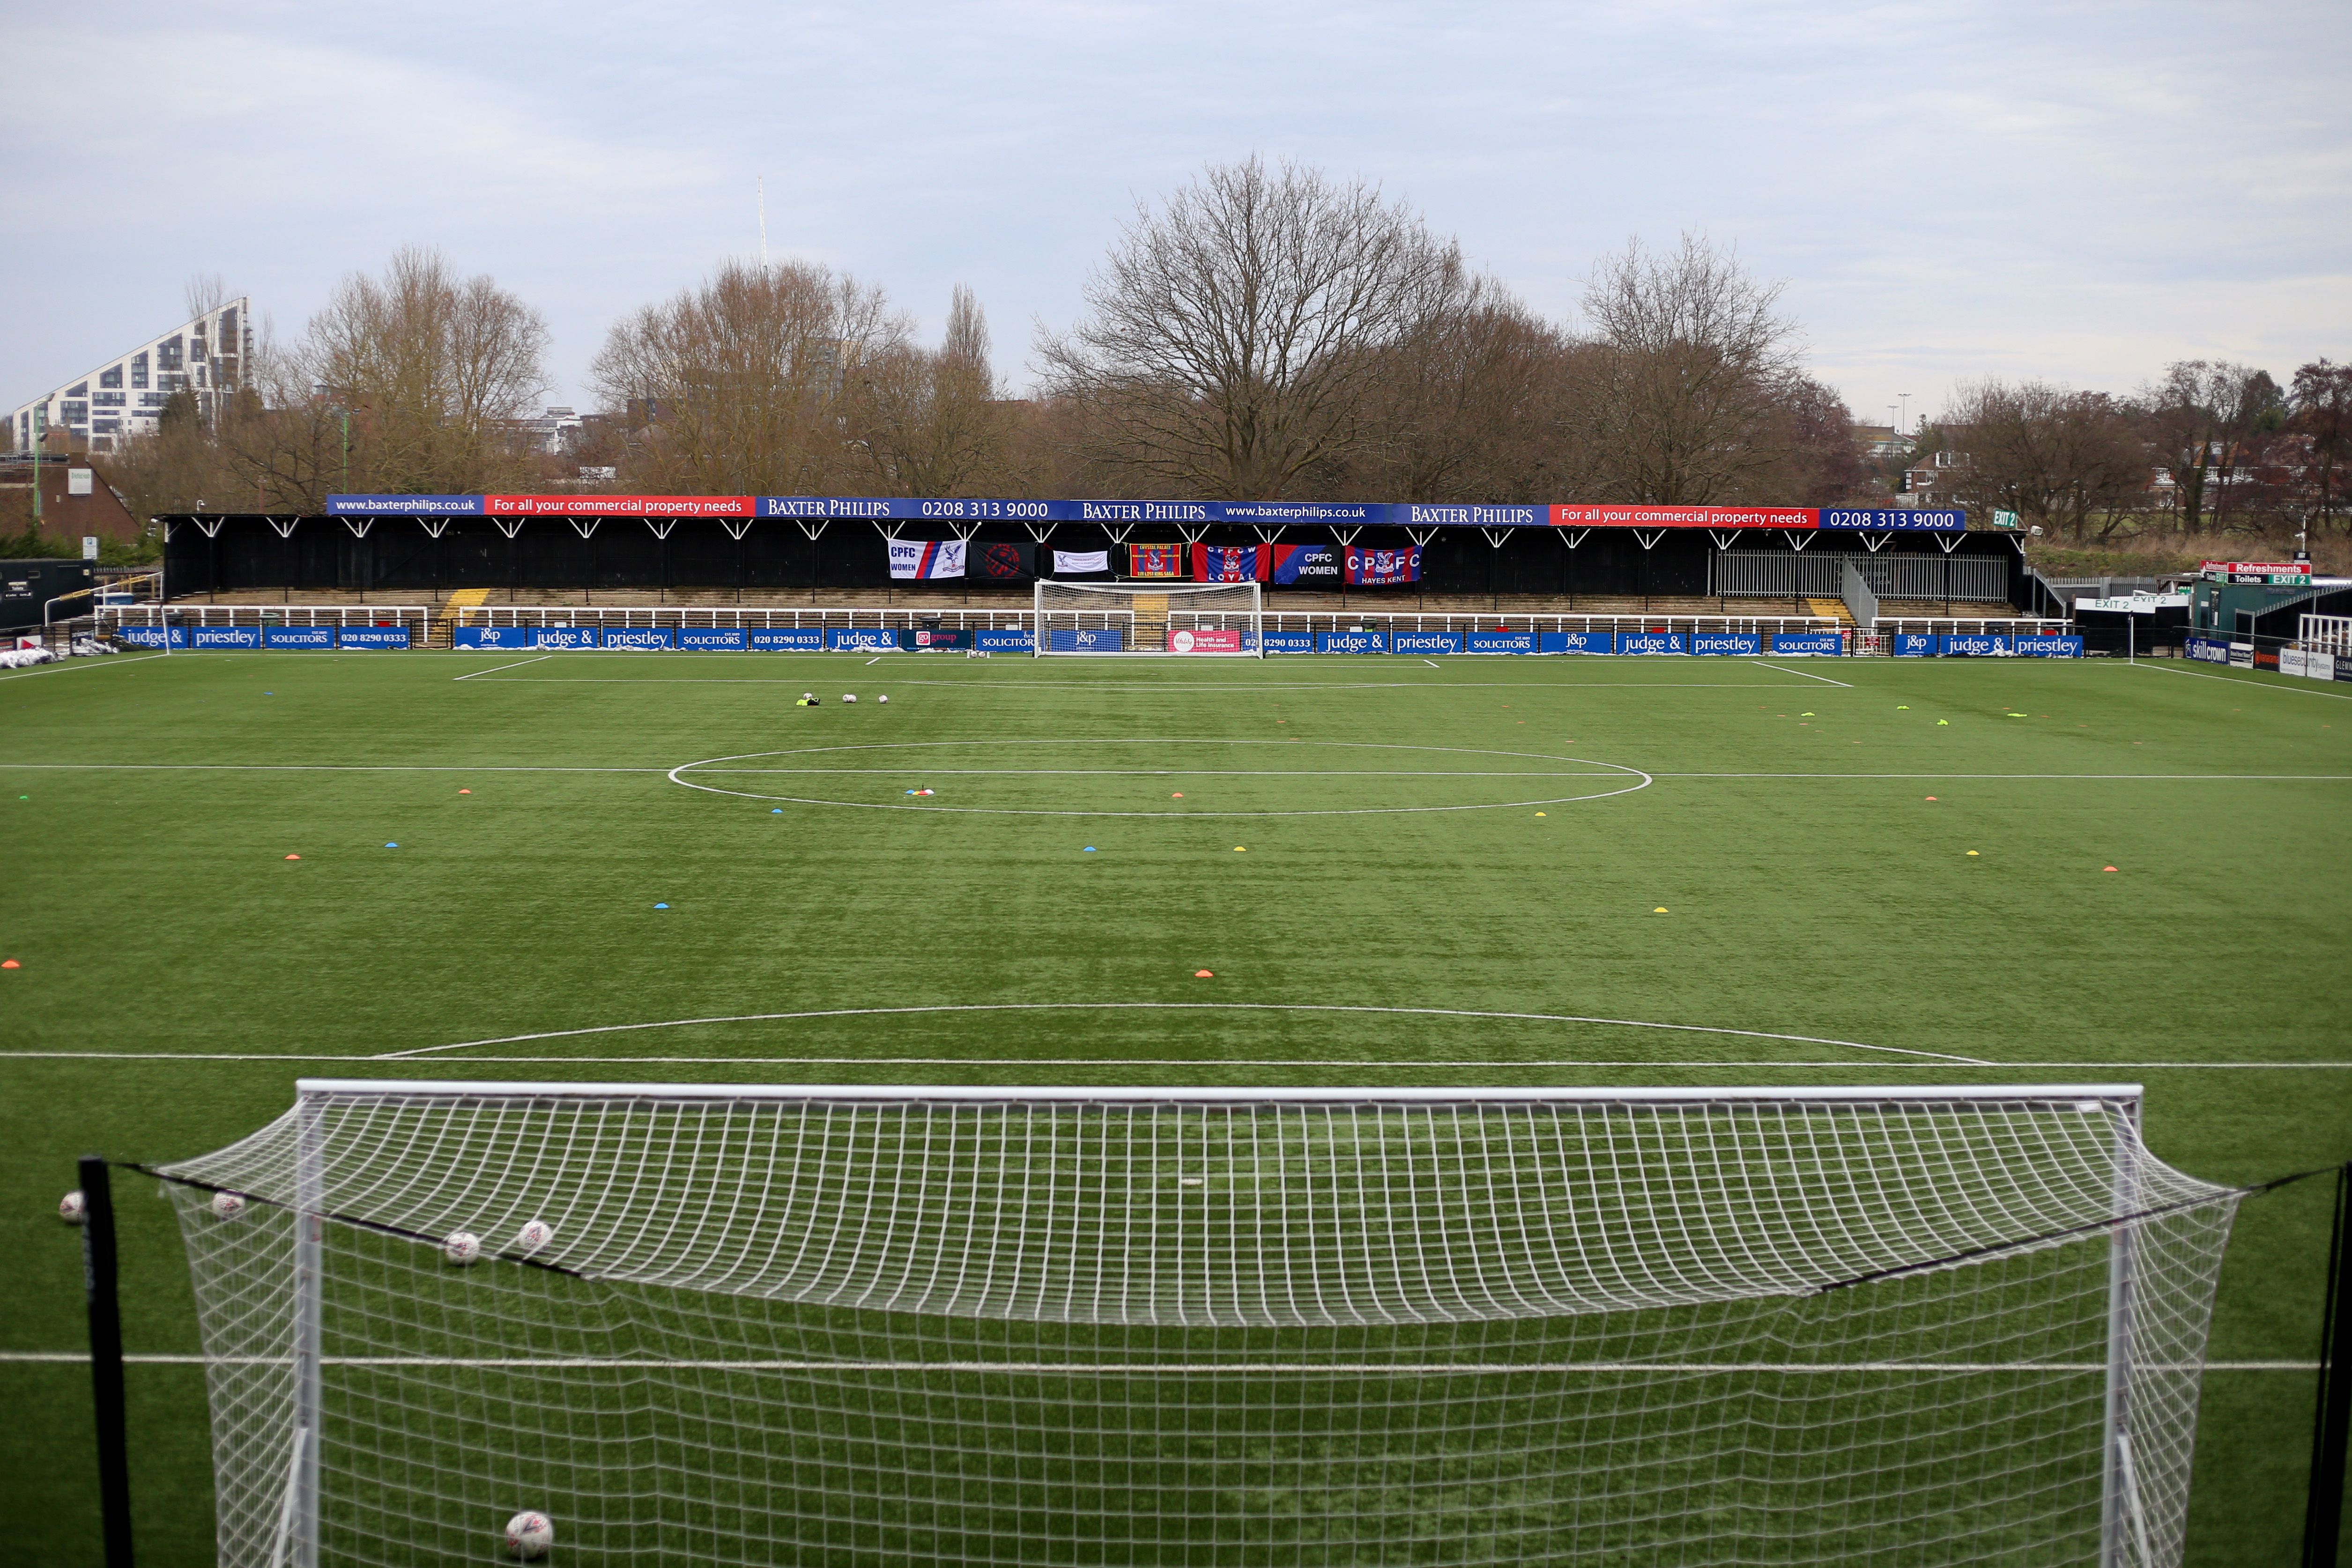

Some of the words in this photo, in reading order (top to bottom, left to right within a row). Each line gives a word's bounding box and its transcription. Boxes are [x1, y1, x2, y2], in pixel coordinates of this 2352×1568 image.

[336, 499, 475, 512] www.baxterphilips.co.uk
[495, 499, 513, 510] For
[518, 499, 532, 510] all
[536, 503, 564, 513] your
[568, 500, 641, 510] commercial
[646, 502, 700, 514] property
[705, 500, 741, 511] needs
[768, 499, 826, 515] BAXTER
[830, 500, 889, 516] PHILIPS
[923, 502, 963, 516] 0208
[970, 503, 999, 516] 313
[1007, 503, 1047, 517] 9000
[1083, 503, 1141, 518] BAXTER
[1146, 503, 1205, 520] PHILIPS
[1226, 506, 1365, 519] www.baxterphilips.co.uk
[1411, 506, 1469, 522] BAXTER
[1473, 507, 1533, 523] PHILIPS
[1562, 509, 1581, 519] For
[1585, 509, 1599, 519] all
[1603, 512, 1631, 523] your
[1635, 510, 1707, 521] commercial
[1712, 513, 1766, 525] property
[1771, 512, 1807, 523] needs
[1831, 512, 1870, 526] 0208
[1878, 513, 1907, 526] 313
[1914, 513, 1953, 526] 9000
[1994, 511, 2010, 525] EXIT
[2010, 514, 2014, 525] 2
[890, 547, 915, 558] CPFC
[1305, 553, 1332, 563] CPFC
[1298, 566, 1337, 575] WOMEN
[2206, 562, 2227, 571] Refreshments
[2237, 564, 2301, 573] Refreshments
[2274, 575, 2297, 584] EXIT
[2300, 576, 2306, 584] 2
[2095, 599, 2120, 608] EXIT
[2123, 600, 2129, 609] 2
[128, 629, 167, 646] judge
[171, 629, 182, 643] &
[197, 630, 255, 646] priestley
[271, 635, 327, 643] SOLICITORS
[479, 628, 500, 643] j&p
[537, 630, 577, 647] judge
[582, 630, 593, 644] &
[608, 631, 668, 648] priestley
[683, 636, 740, 644] SOLICITORS
[836, 631, 876, 648] judge
[882, 631, 892, 645] &
[931, 634, 957, 643] group
[1076, 631, 1096, 645] j&p
[1176, 637, 1192, 646] Vitality
[1326, 635, 1366, 651] judge
[1372, 635, 1383, 648] &
[1397, 635, 1457, 651] priestley
[1566, 633, 1587, 648] j&p
[1906, 635, 1927, 650] j&p
[1474, 640, 1530, 648] SOLICITORS
[1625, 636, 1665, 652] judge
[1670, 636, 1681, 649] &
[1695, 636, 1756, 653] priestley
[1779, 642, 1834, 650] SOLICITORS
[1948, 638, 1989, 654] judge
[1994, 637, 2004, 651] &
[2018, 638, 2078, 655] priestley
